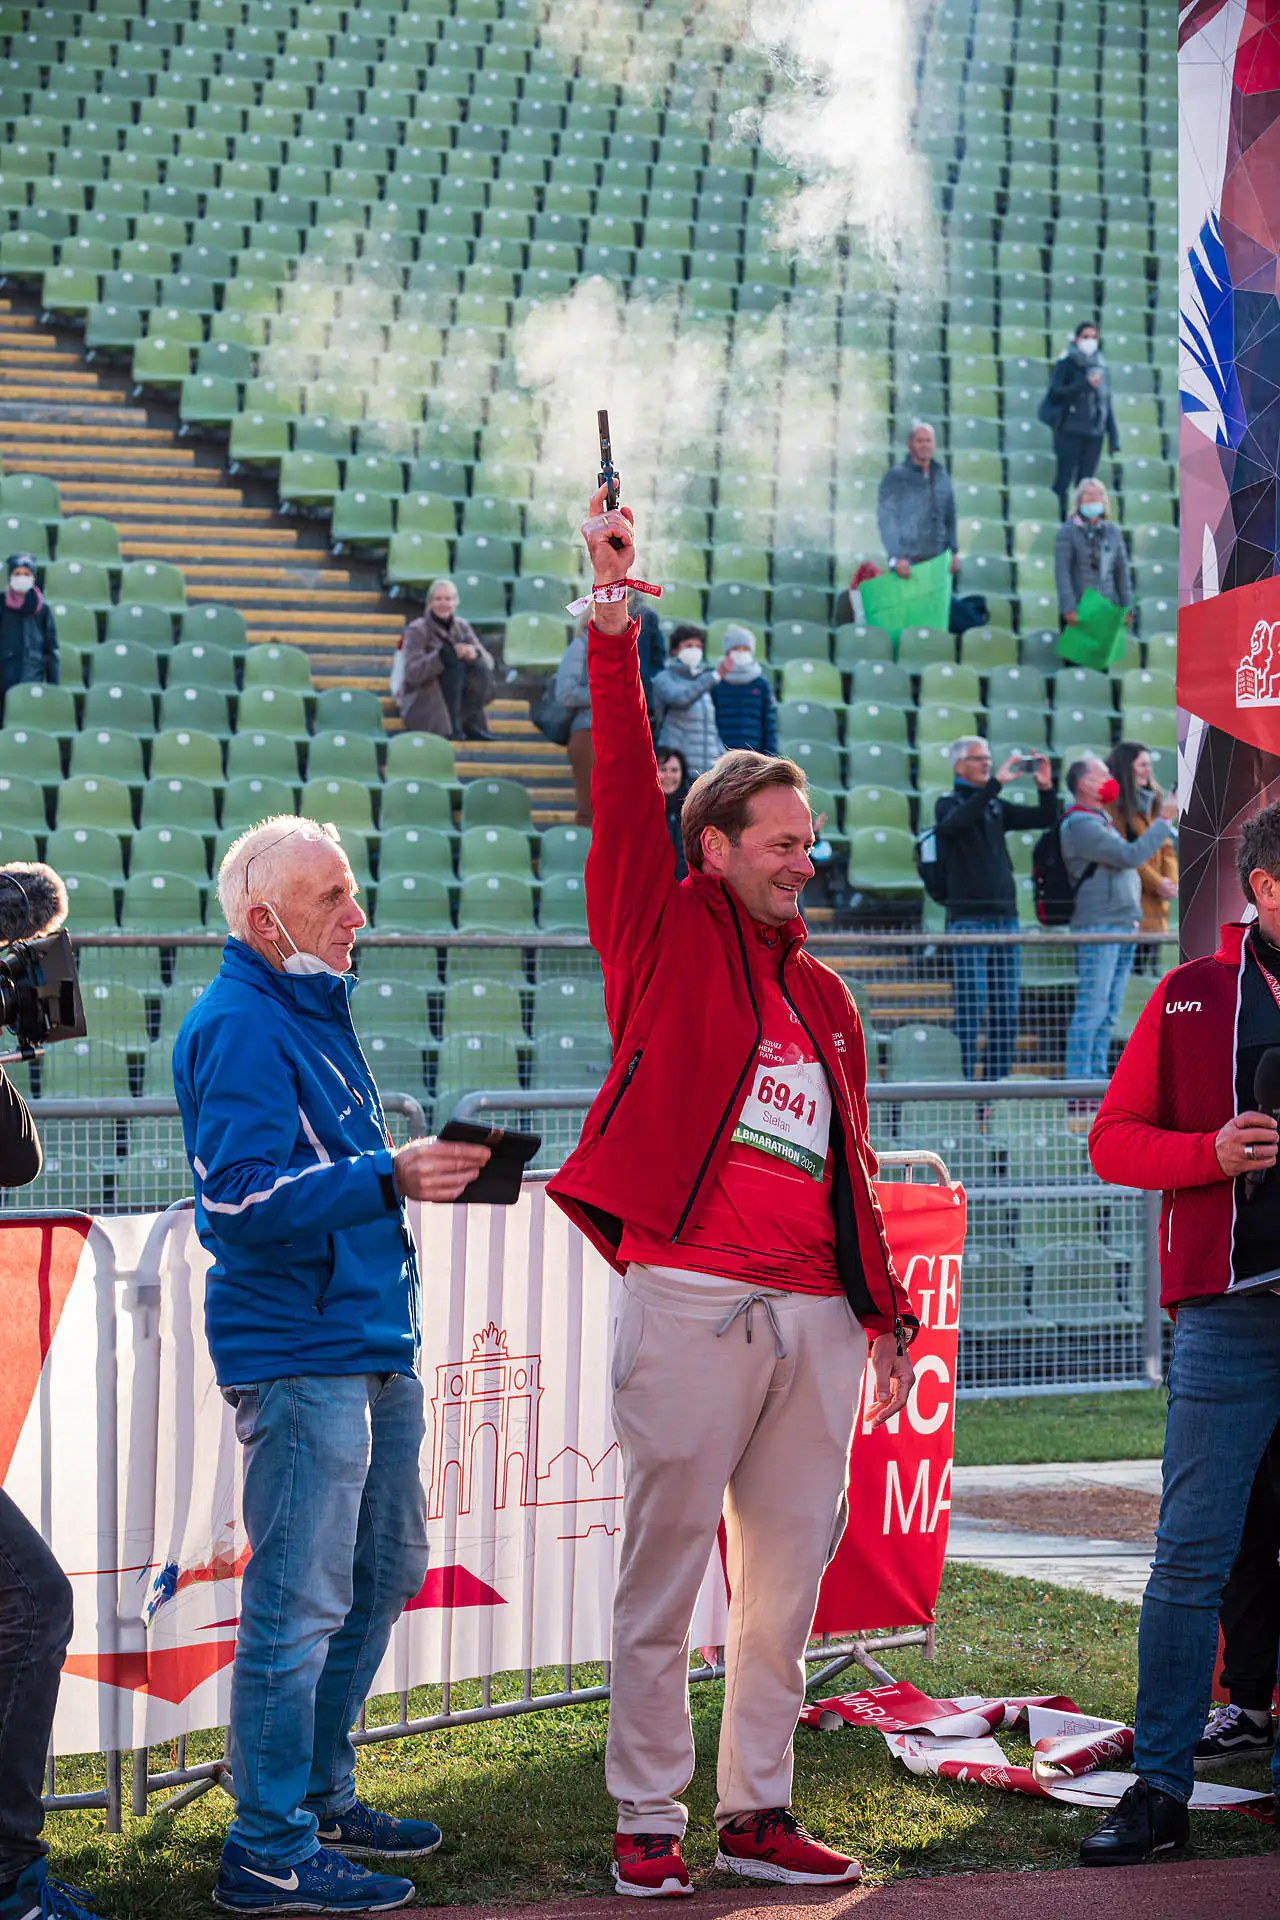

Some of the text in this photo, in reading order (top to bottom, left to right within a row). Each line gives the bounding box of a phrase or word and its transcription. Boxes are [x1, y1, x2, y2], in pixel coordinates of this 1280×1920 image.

[759, 1052, 785, 1063] RATHON
[757, 1075, 817, 1126] 6941
[762, 1110, 791, 1133] Stefan
[800, 1156, 816, 1174] 2021
